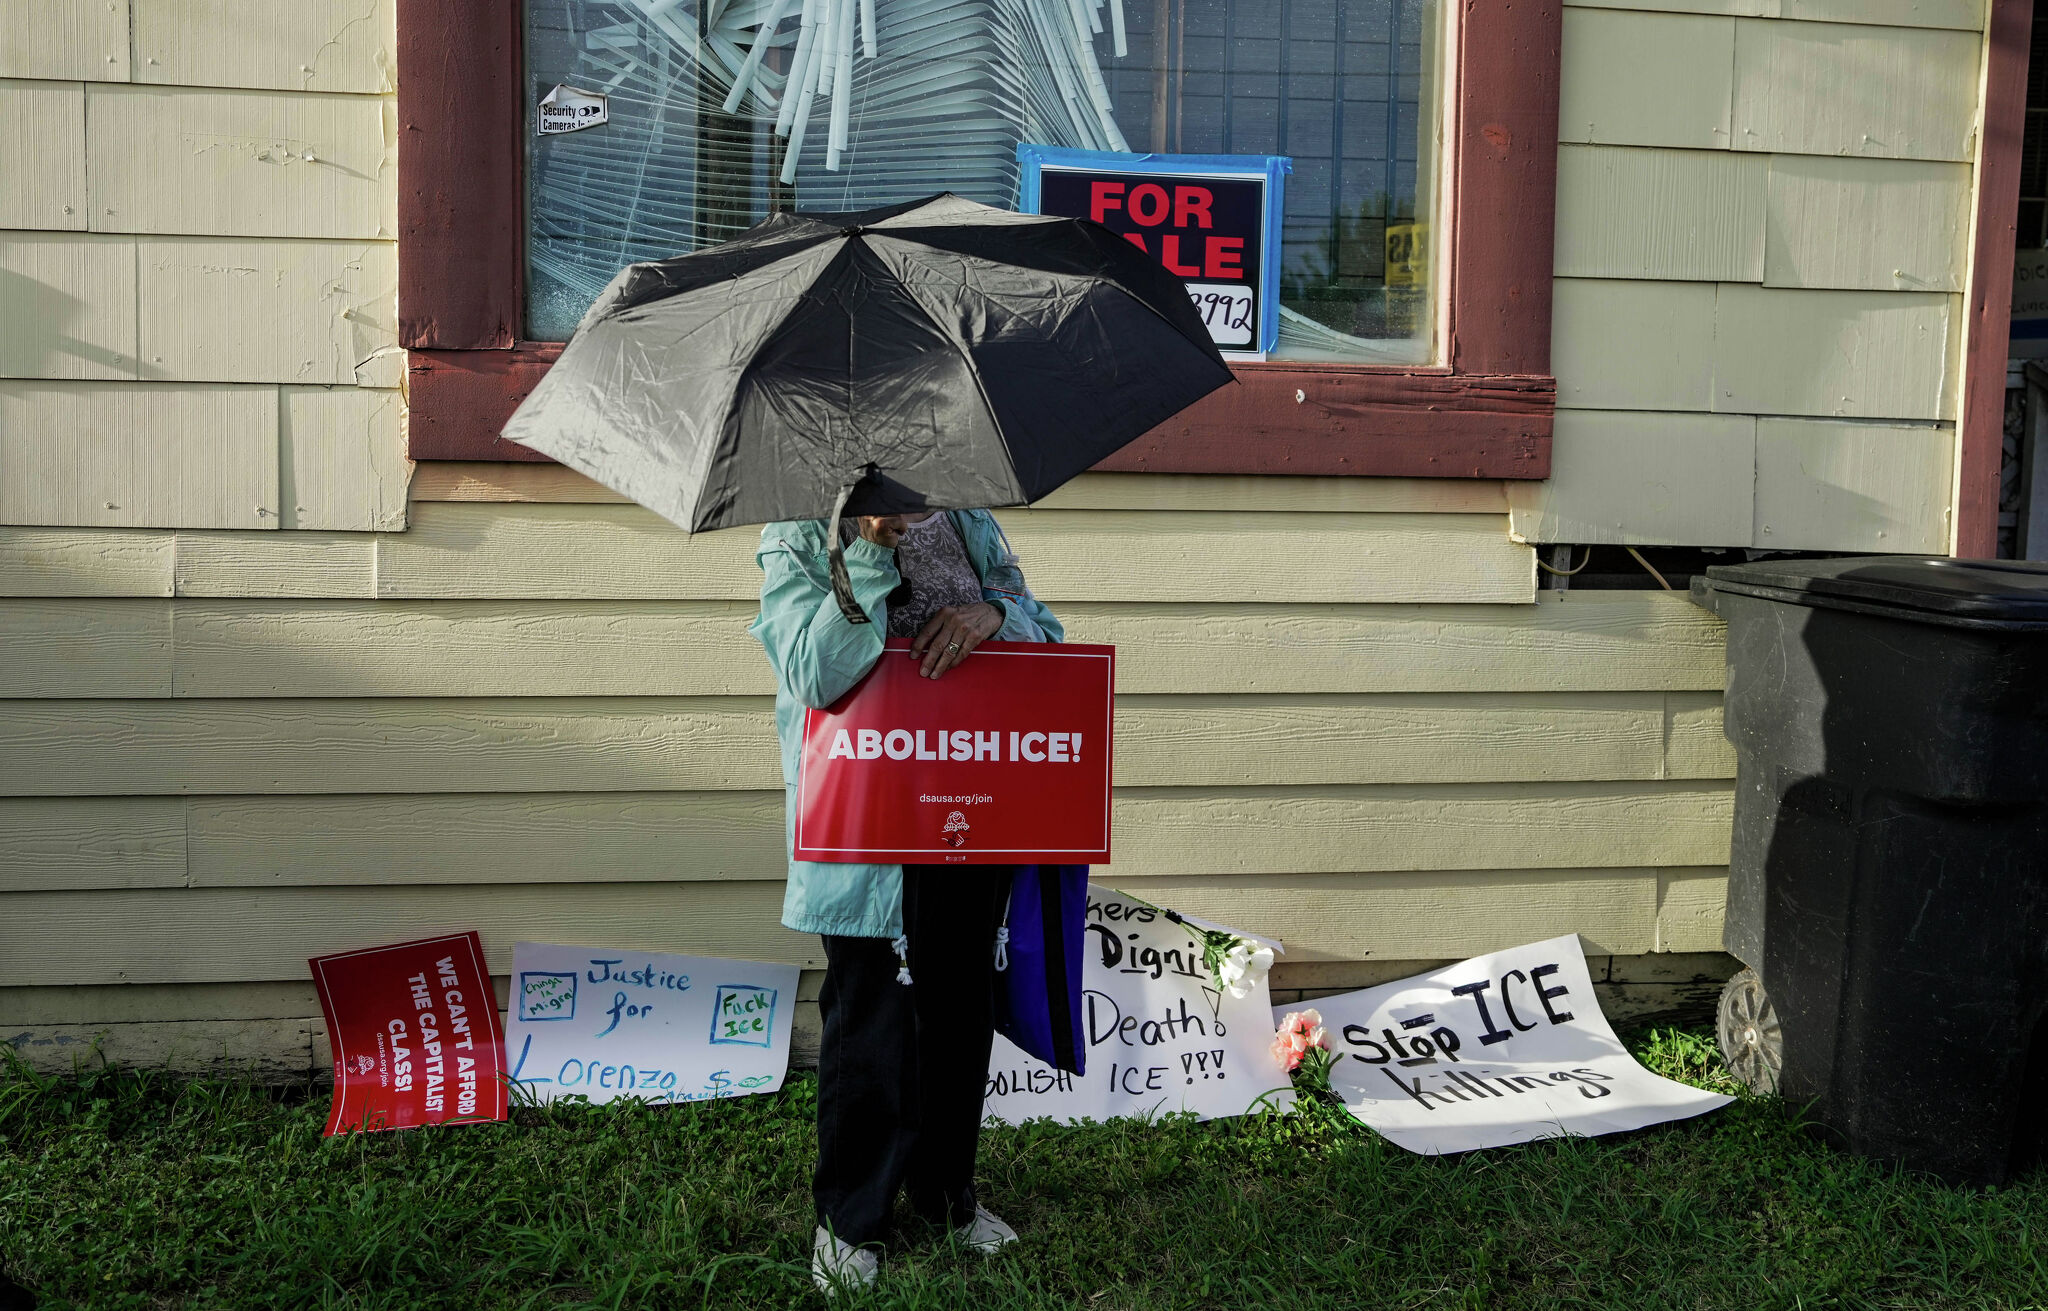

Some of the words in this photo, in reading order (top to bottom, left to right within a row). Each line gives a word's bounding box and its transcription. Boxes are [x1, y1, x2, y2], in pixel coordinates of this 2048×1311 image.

[543, 105, 576, 118] Security
[543, 120, 576, 131] Cameras
[1090, 181, 1214, 229] FOR
[828, 729, 1000, 762] ABOLISH
[1009, 731, 1083, 763] ICE!
[919, 793, 993, 805] dsausa.org/join
[408, 972, 433, 1010] THE
[435, 955, 459, 988] WE
[587, 959, 693, 991] Justice
[445, 990, 473, 1051] CAN'T
[594, 991, 654, 1038] for
[1083, 985, 1227, 1046] Death!
[1343, 1023, 1461, 1064] Stop
[1451, 963, 1576, 1046] ICE
[376, 1032, 389, 1087] dsausa.org/join
[388, 1019, 413, 1092] CLASS!
[419, 1012, 444, 1112] CAPITALIST
[509, 1034, 677, 1089] Lorenzo
[1110, 1063, 1169, 1095] ICE
[457, 1056, 477, 1115] AFFORD
